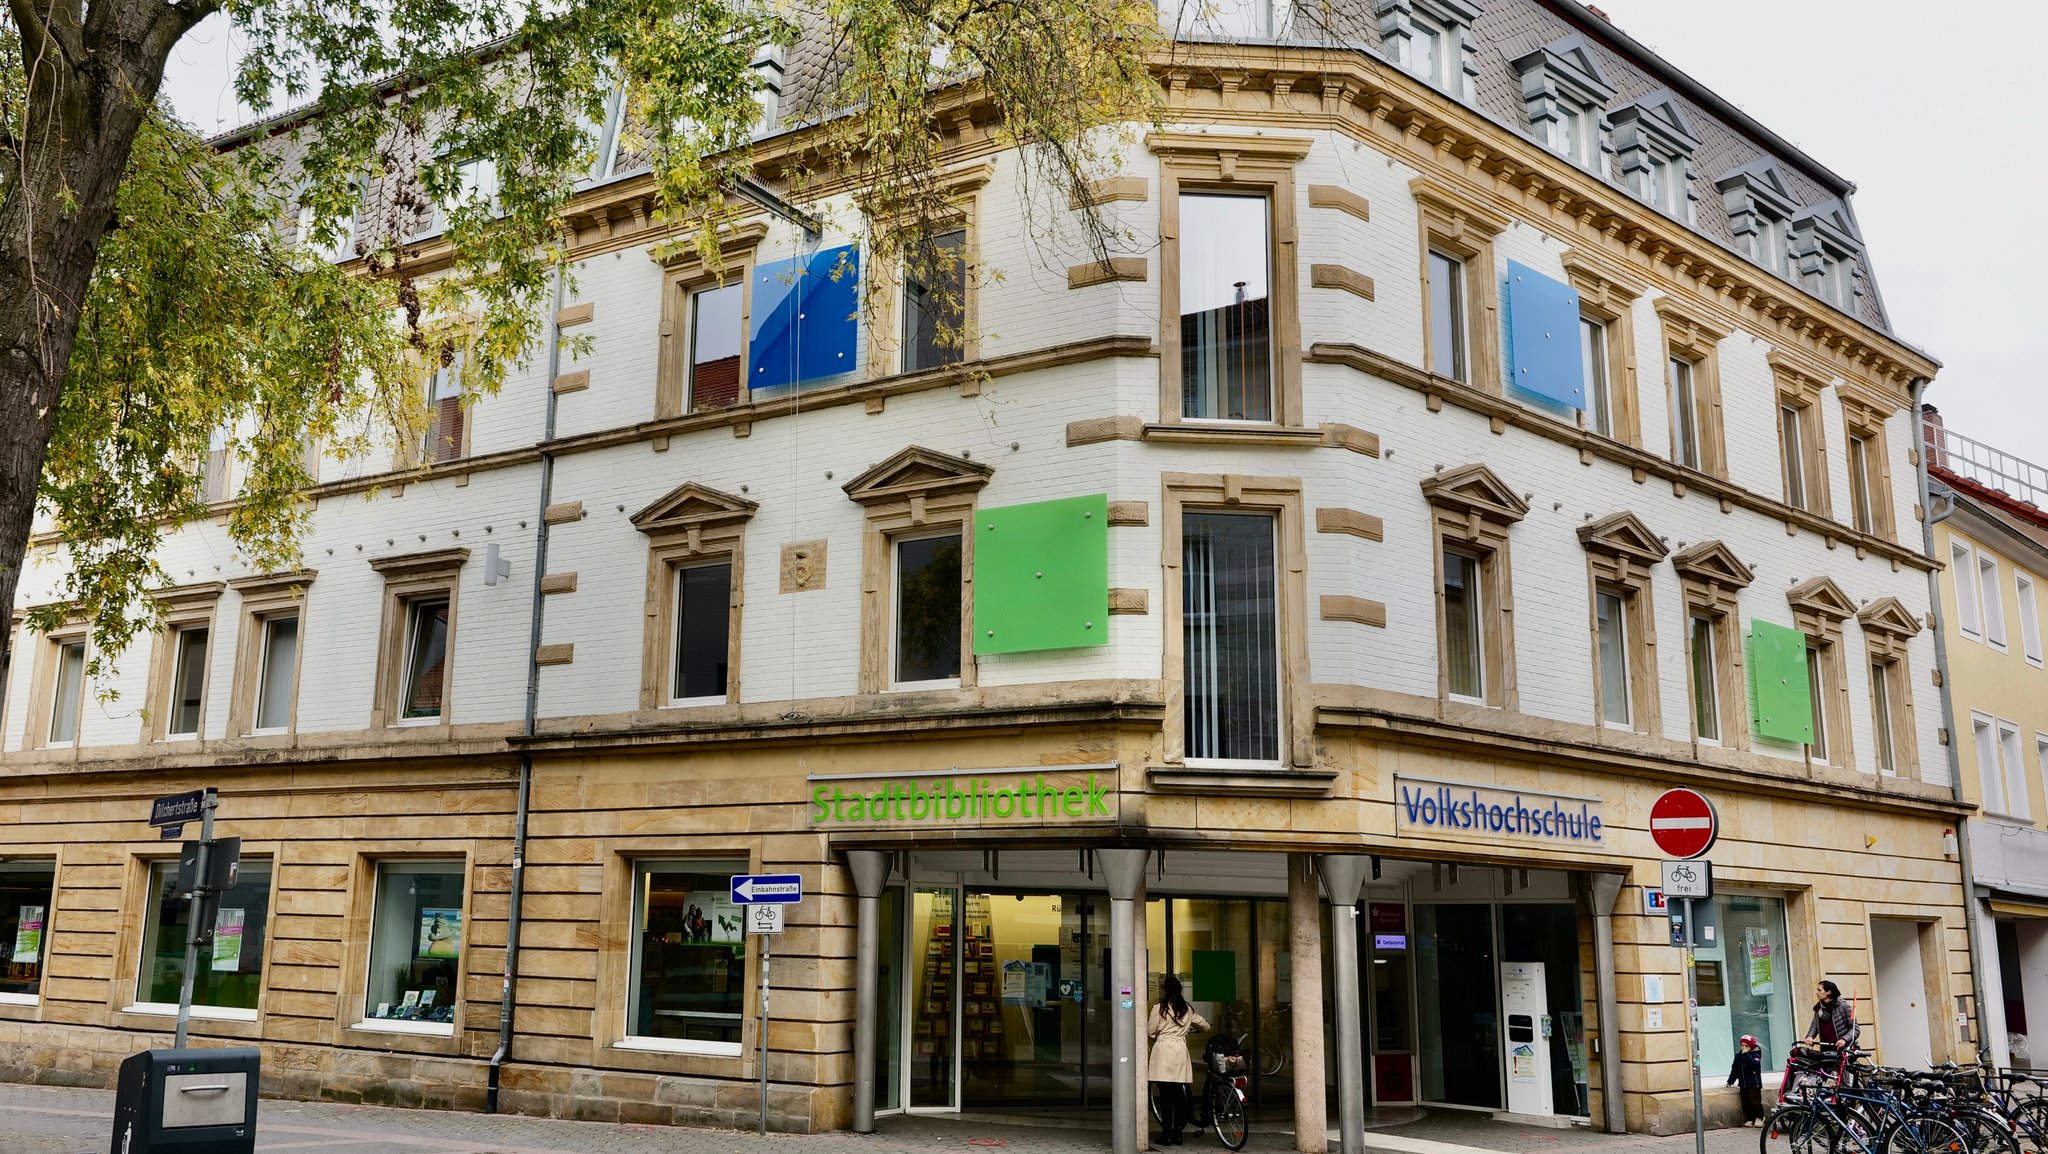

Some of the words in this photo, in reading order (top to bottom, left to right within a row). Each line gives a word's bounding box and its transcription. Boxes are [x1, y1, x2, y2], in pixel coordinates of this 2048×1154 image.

[154, 797, 198, 819] Dilchertstraße
[812, 774, 1110, 822] Stadtbibliothek
[1402, 785, 1602, 841] Volkshochschule
[751, 885, 797, 893] Einbahnstraße
[1677, 885, 1692, 893] frei
